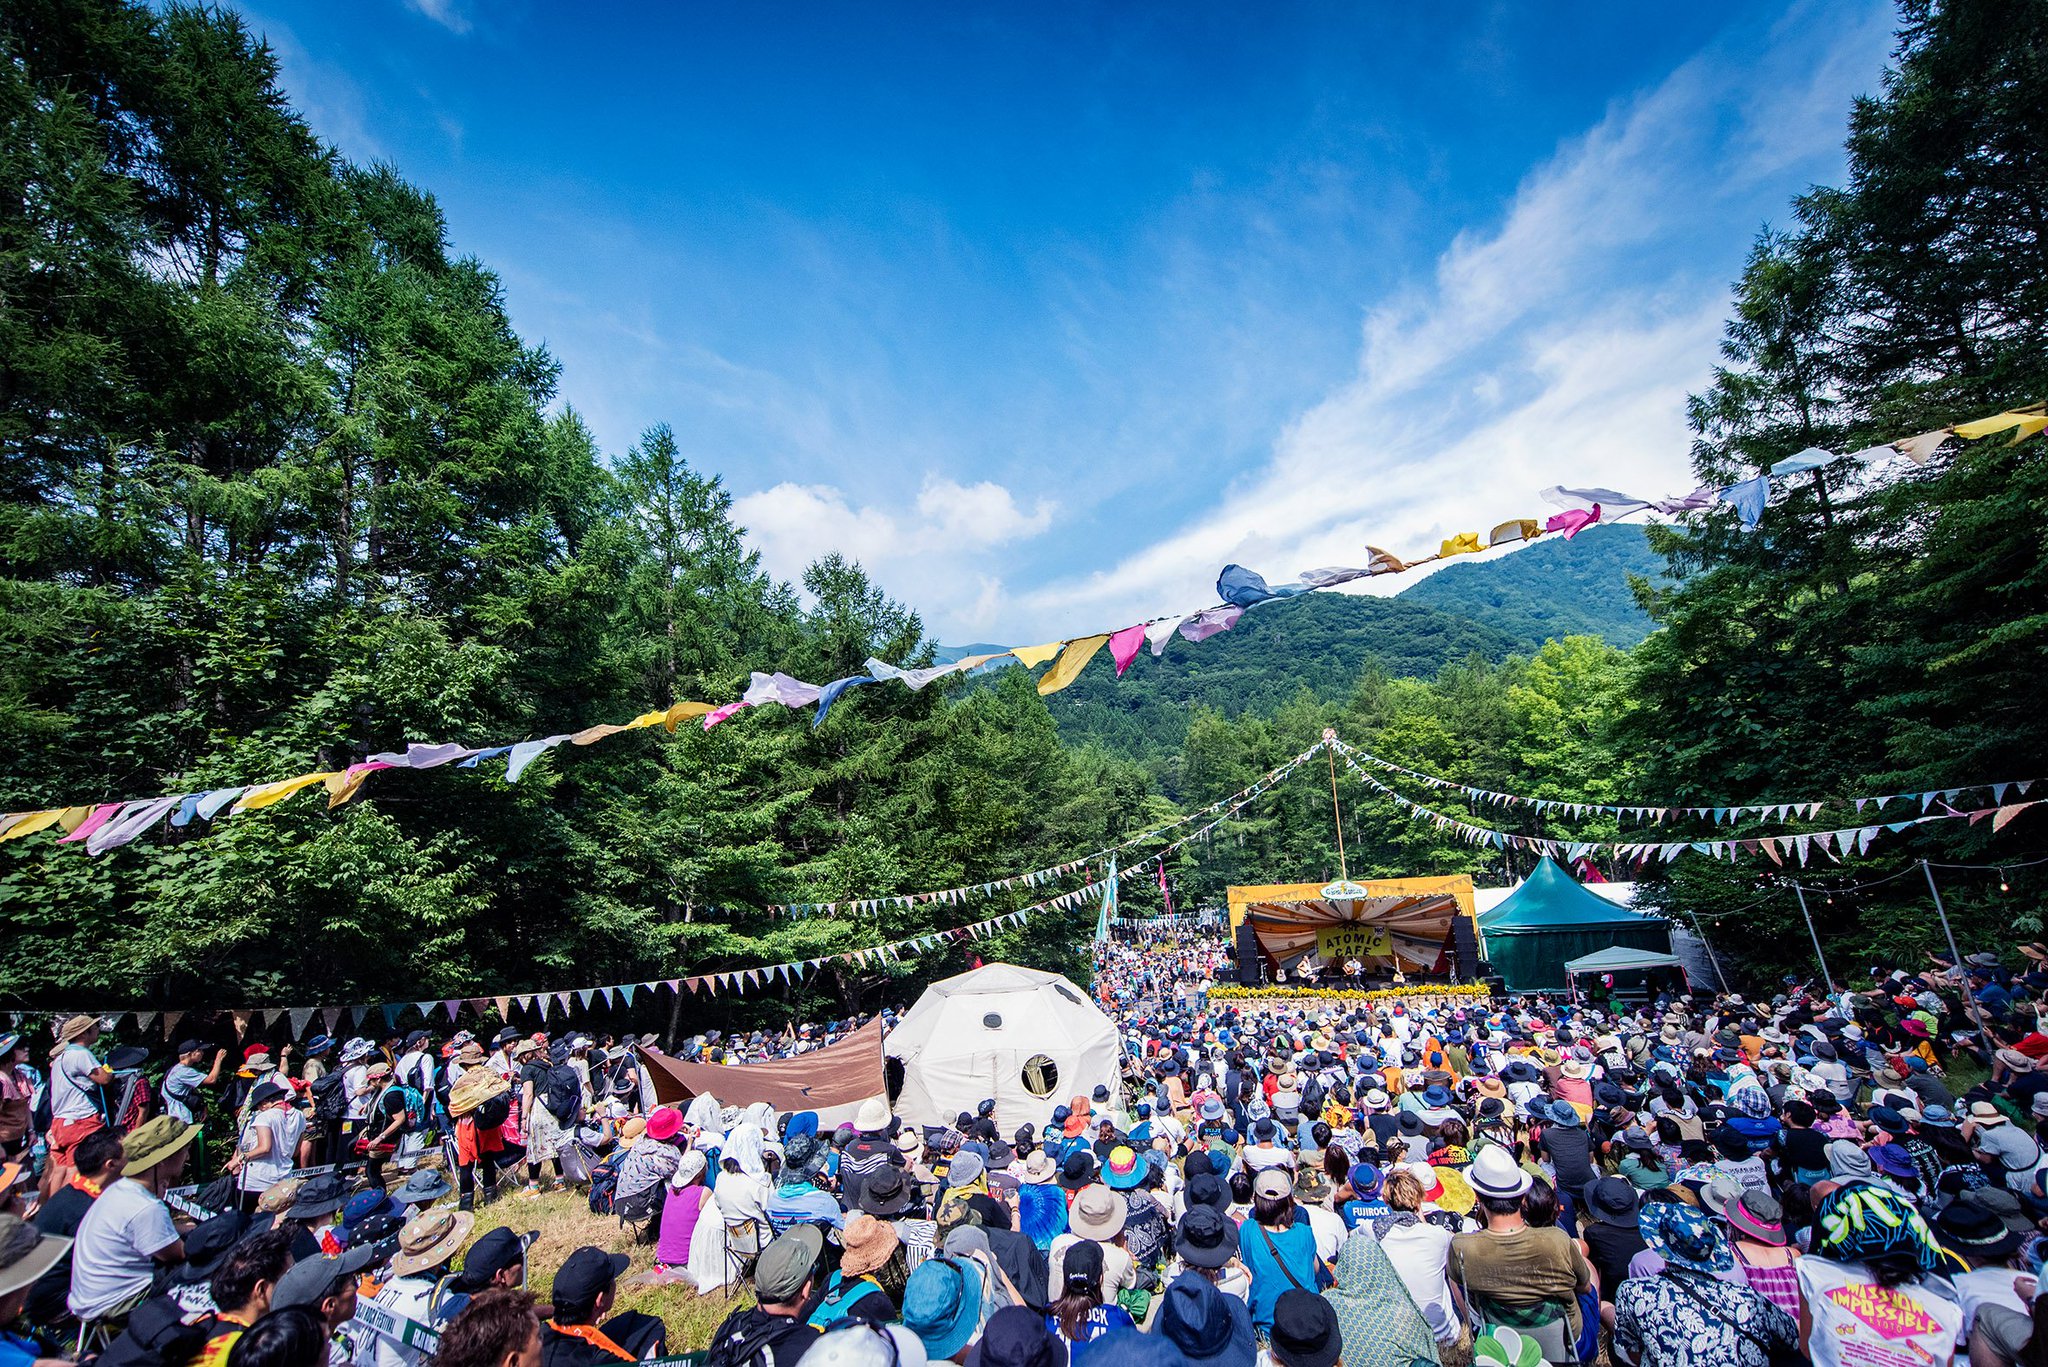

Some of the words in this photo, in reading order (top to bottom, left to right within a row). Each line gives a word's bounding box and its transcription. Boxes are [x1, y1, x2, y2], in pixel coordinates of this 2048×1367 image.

[1326, 933, 1382, 949] ATOMIC
[1335, 945, 1371, 958] CAFE
[1352, 1206, 1390, 1217] FUJIROCK
[1844, 1277, 1925, 1317] MISSION
[363, 1305, 379, 1327] ROCK
[375, 1311, 397, 1335] FESTIVAL
[1832, 1290, 1937, 1337] IMPOSSIBLE
